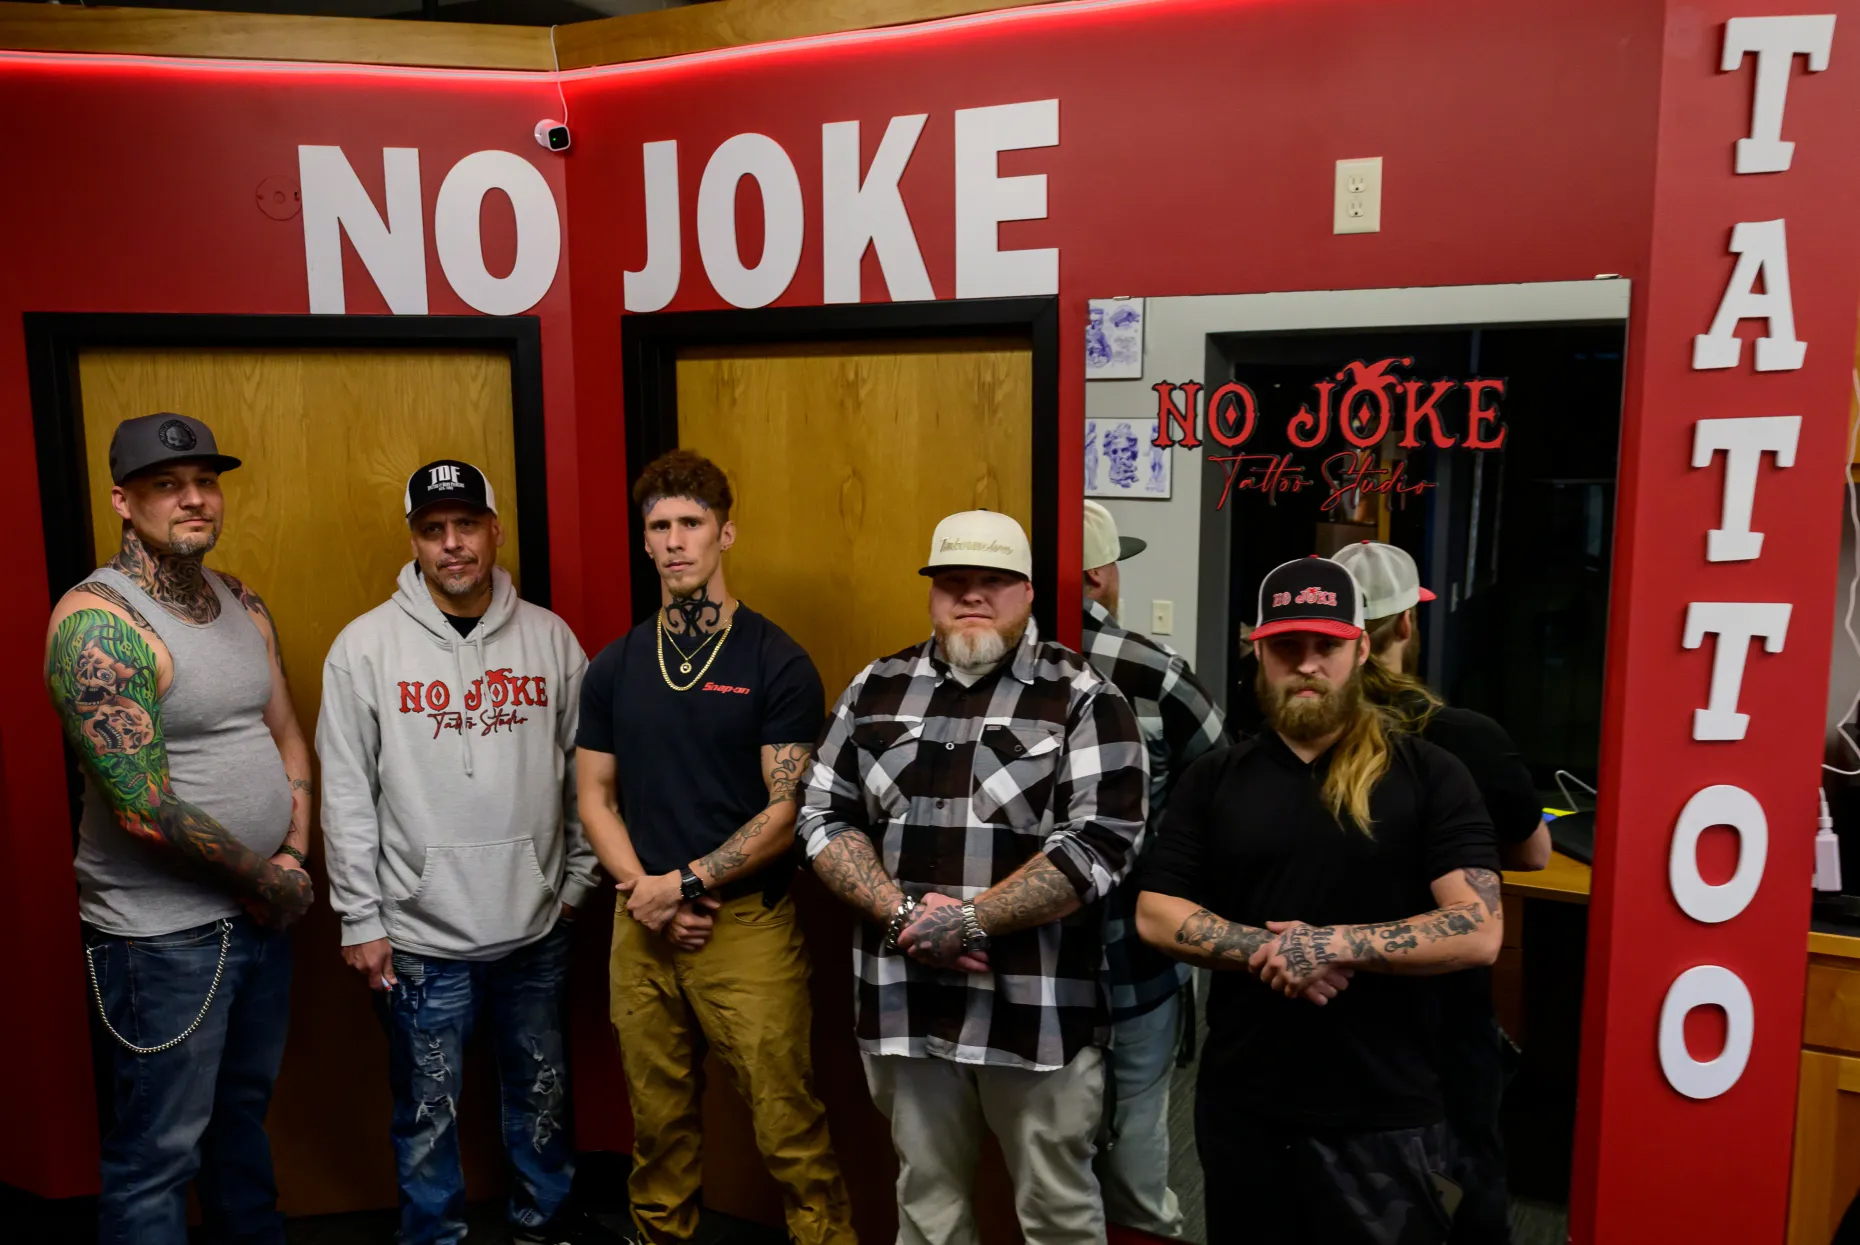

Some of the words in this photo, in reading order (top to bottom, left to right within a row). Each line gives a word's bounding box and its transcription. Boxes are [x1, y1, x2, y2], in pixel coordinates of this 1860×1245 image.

[298, 145, 562, 316] NO
[623, 98, 1060, 313] JOKE
[1152, 379, 1259, 450] NO
[1286, 356, 1508, 450] JOKE
[428, 465, 461, 485] TDF
[1207, 452, 1312, 512] Tattoo
[1320, 450, 1438, 512] Studio
[1657, 14, 1835, 1101] TATTOO
[1272, 591, 1292, 607] NO
[1295, 586, 1337, 607] JOKE
[398, 680, 450, 713] NO
[464, 668, 548, 711] JOKE
[702, 681, 750, 695] Snap-on
